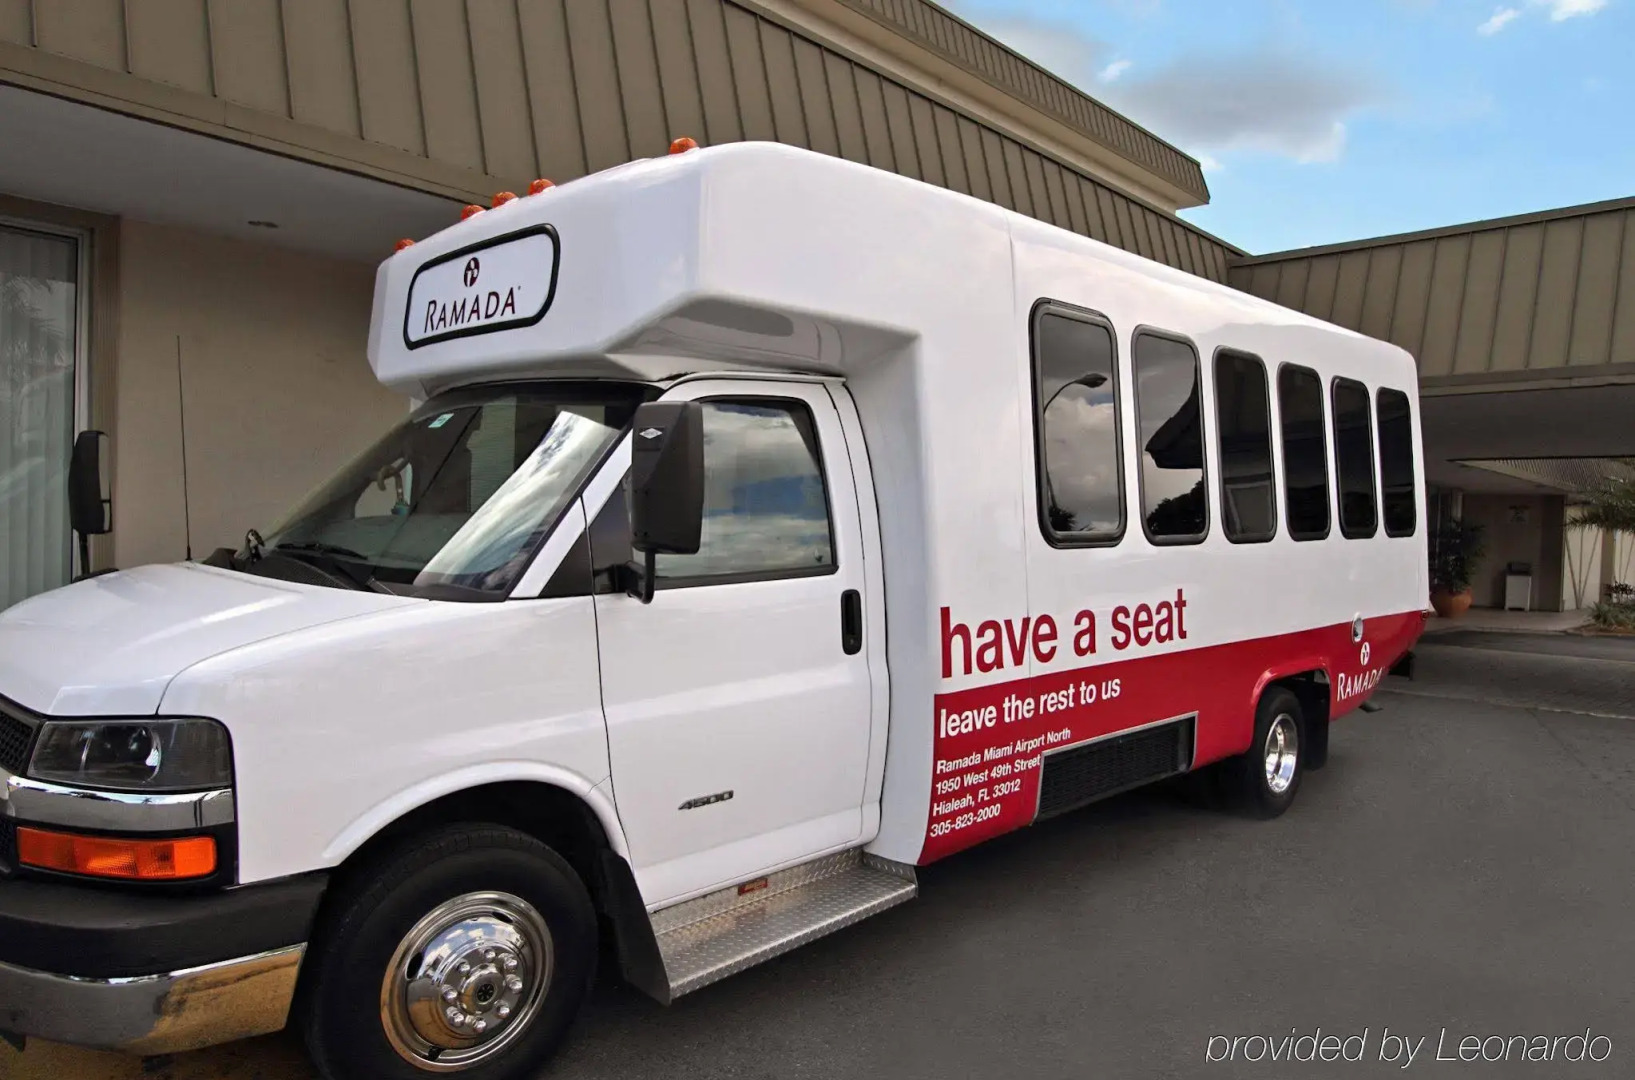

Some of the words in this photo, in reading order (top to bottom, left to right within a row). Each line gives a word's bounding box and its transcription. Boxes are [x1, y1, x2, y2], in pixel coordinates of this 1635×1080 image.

[424, 287, 516, 333] RAMADA
[940, 606, 1058, 679] have
[1073, 609, 1096, 657] a
[1110, 588, 1187, 650] seat
[939, 708, 997, 738] leave
[1002, 693, 1035, 723] the
[1039, 683, 1075, 714] rest
[1079, 681, 1097, 703] to
[1101, 678, 1121, 700] us
[936, 752, 981, 774] Ramada
[983, 742, 1013, 762] Miami
[1014, 734, 1045, 753] Airport
[1047, 727, 1071, 744] North
[936, 776, 961, 795] 1950
[963, 770, 988, 787] West
[990, 762, 1012, 779] 49th
[1014, 754, 1041, 772] Street
[930, 803, 1001, 837] 305-823-2000
[932, 793, 975, 817] Hialeah,
[978, 788, 990, 803] FL
[992, 779, 1021, 798] 33012
